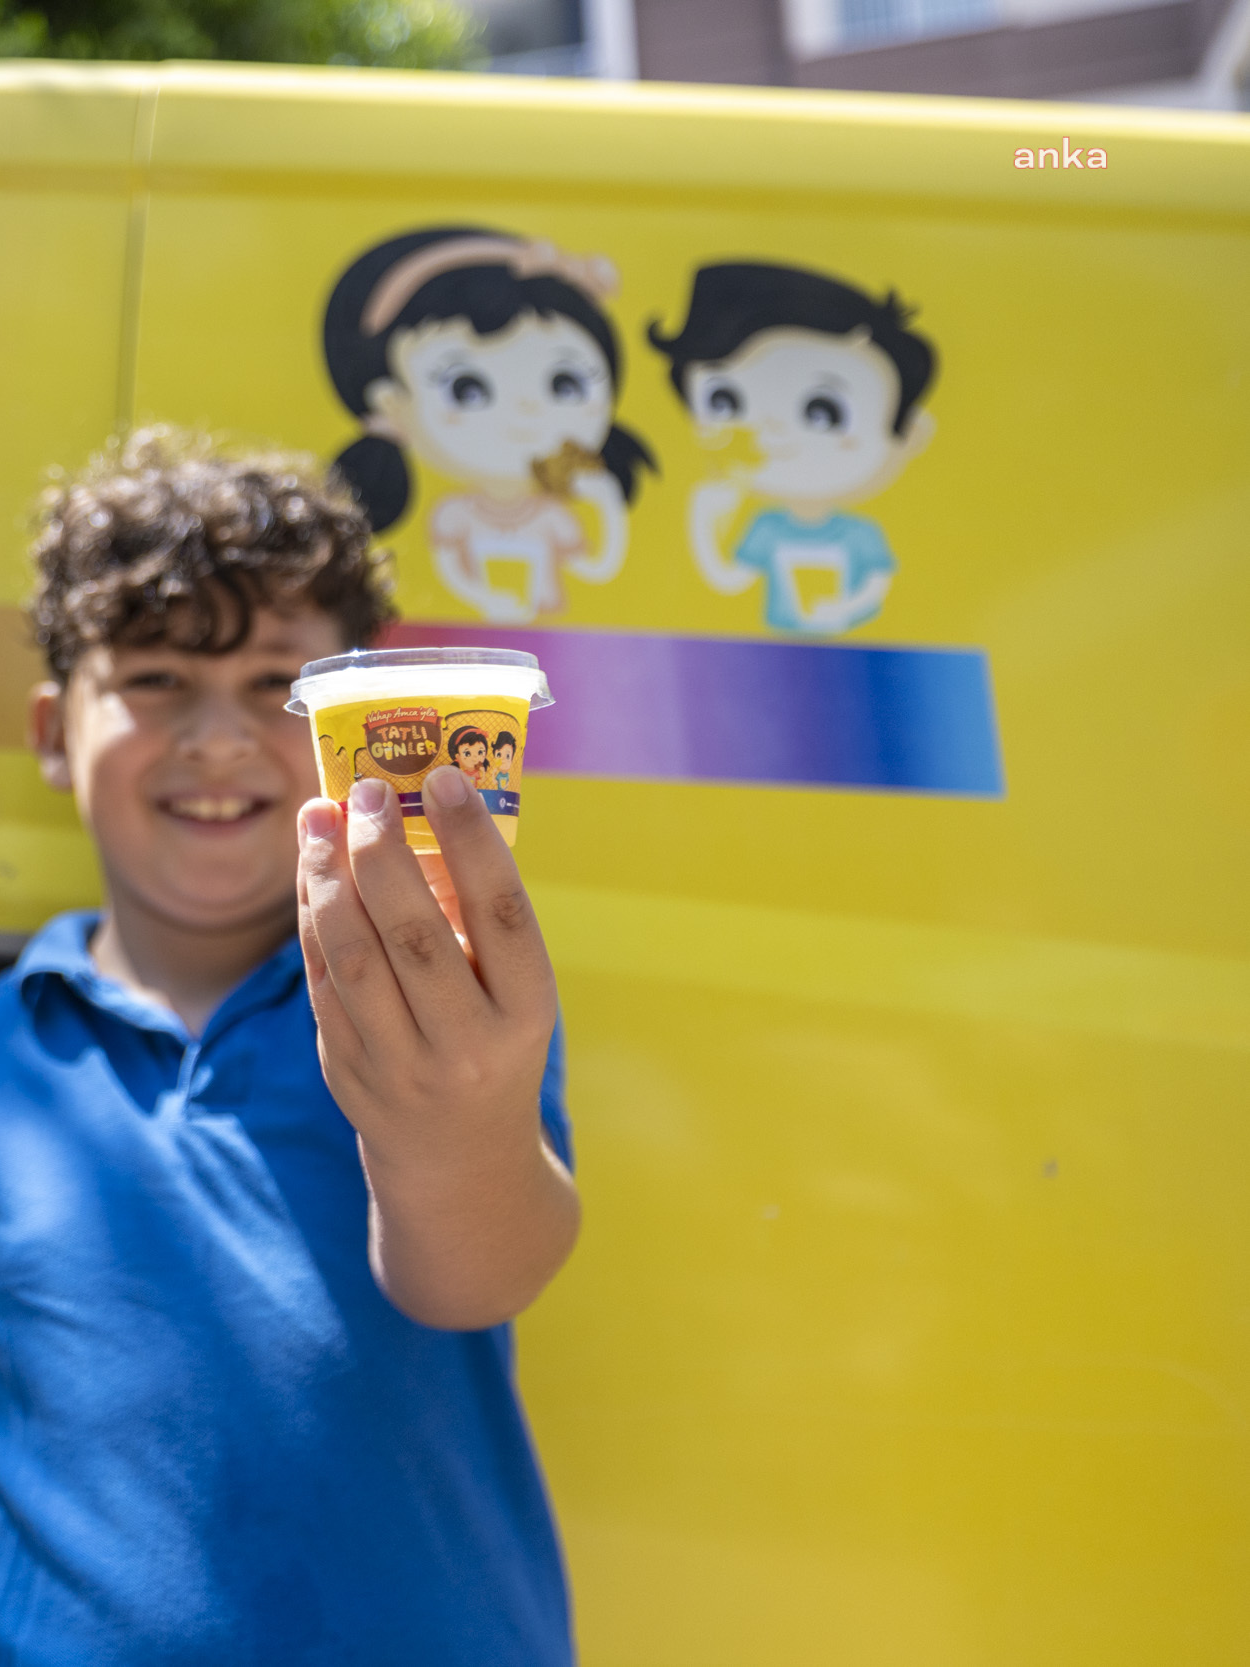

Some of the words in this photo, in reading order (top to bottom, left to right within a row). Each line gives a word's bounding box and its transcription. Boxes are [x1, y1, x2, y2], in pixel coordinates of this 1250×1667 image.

[367, 711, 392, 723] Vahap
[377, 725, 427, 741] TATLI
[371, 741, 437, 760] GÜNLER
